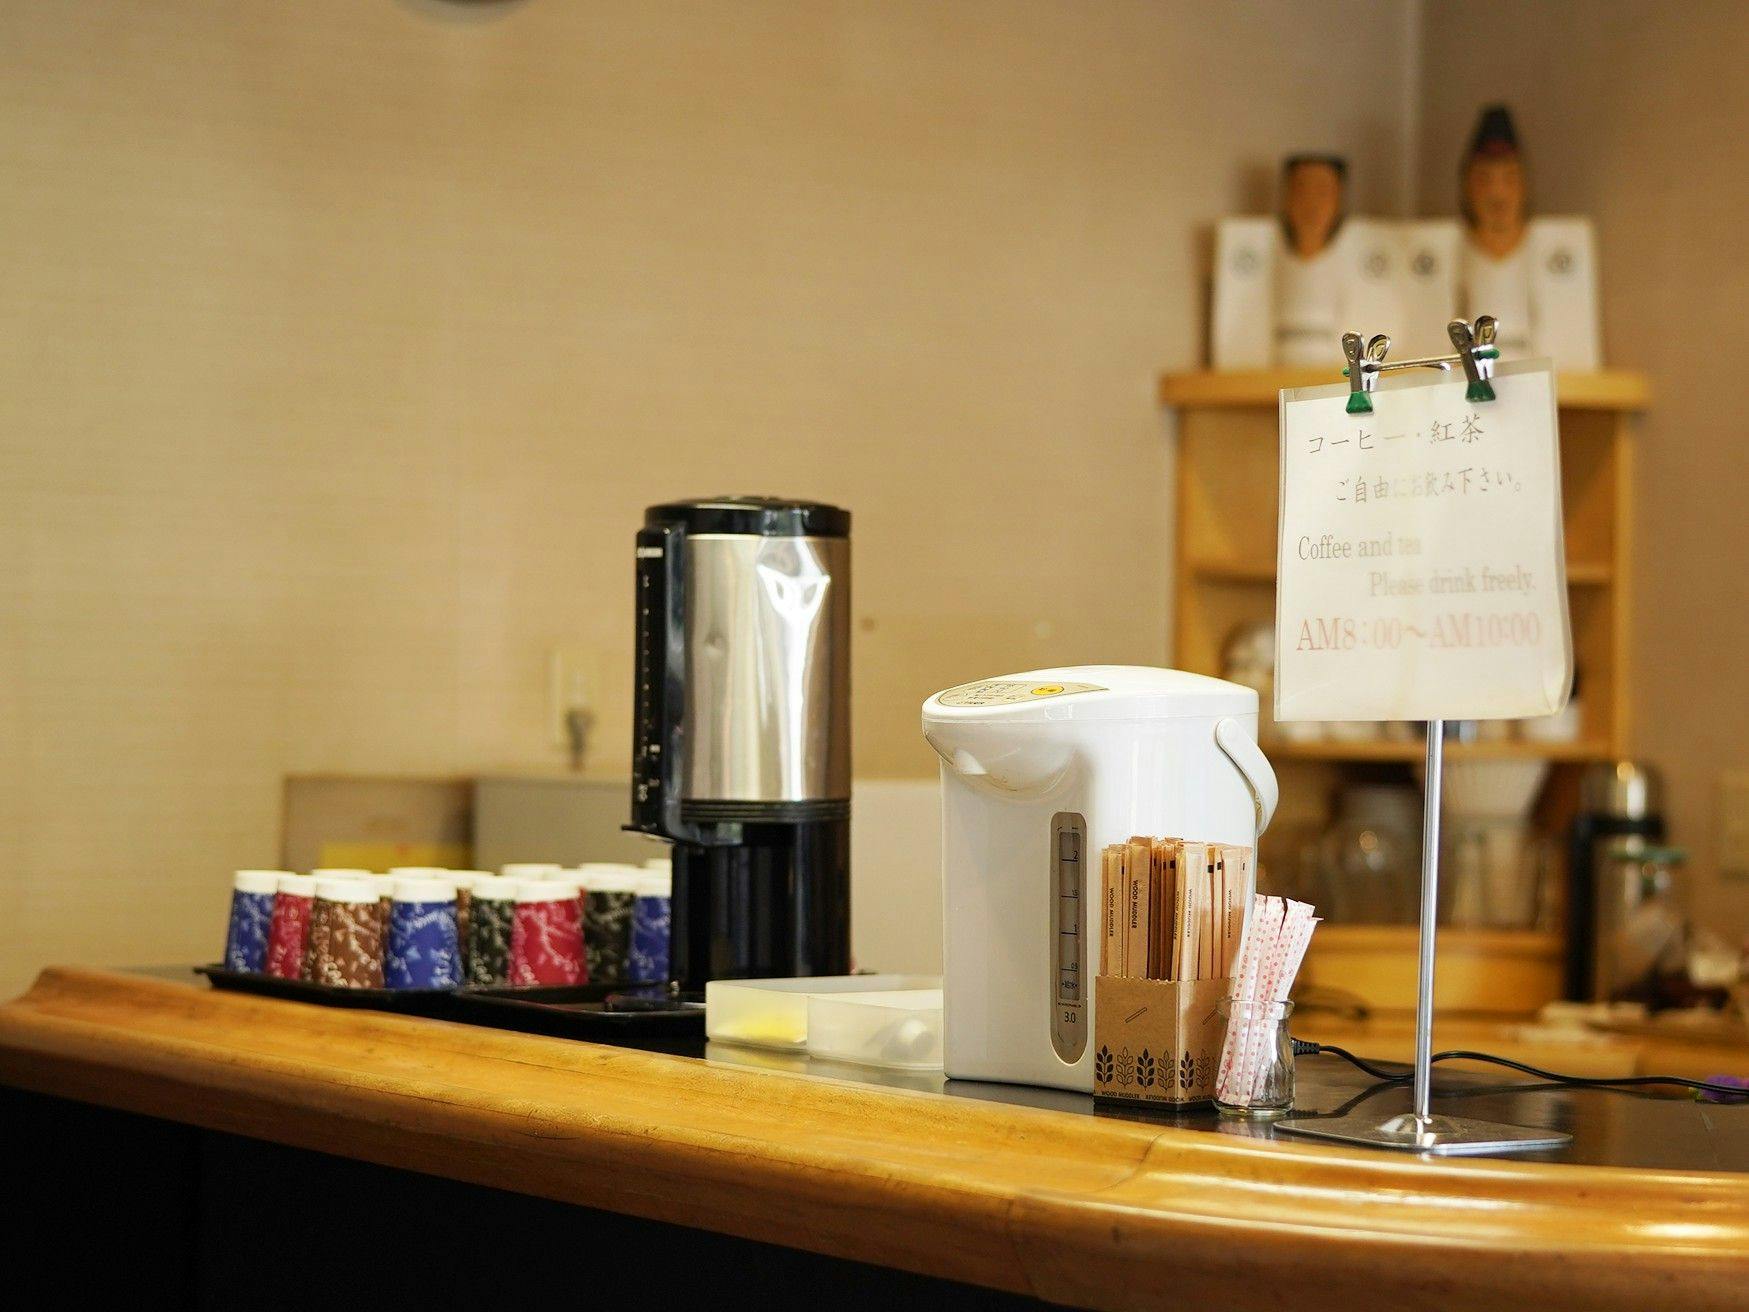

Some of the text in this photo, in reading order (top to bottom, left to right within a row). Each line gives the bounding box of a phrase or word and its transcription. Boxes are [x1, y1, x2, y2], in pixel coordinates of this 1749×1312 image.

[1298, 534, 1352, 561] Coffee
[1358, 530, 1393, 557] and
[1368, 570, 1424, 597] Please
[1429, 567, 1477, 594] drink
[1064, 1011, 1076, 1023] 3.0
